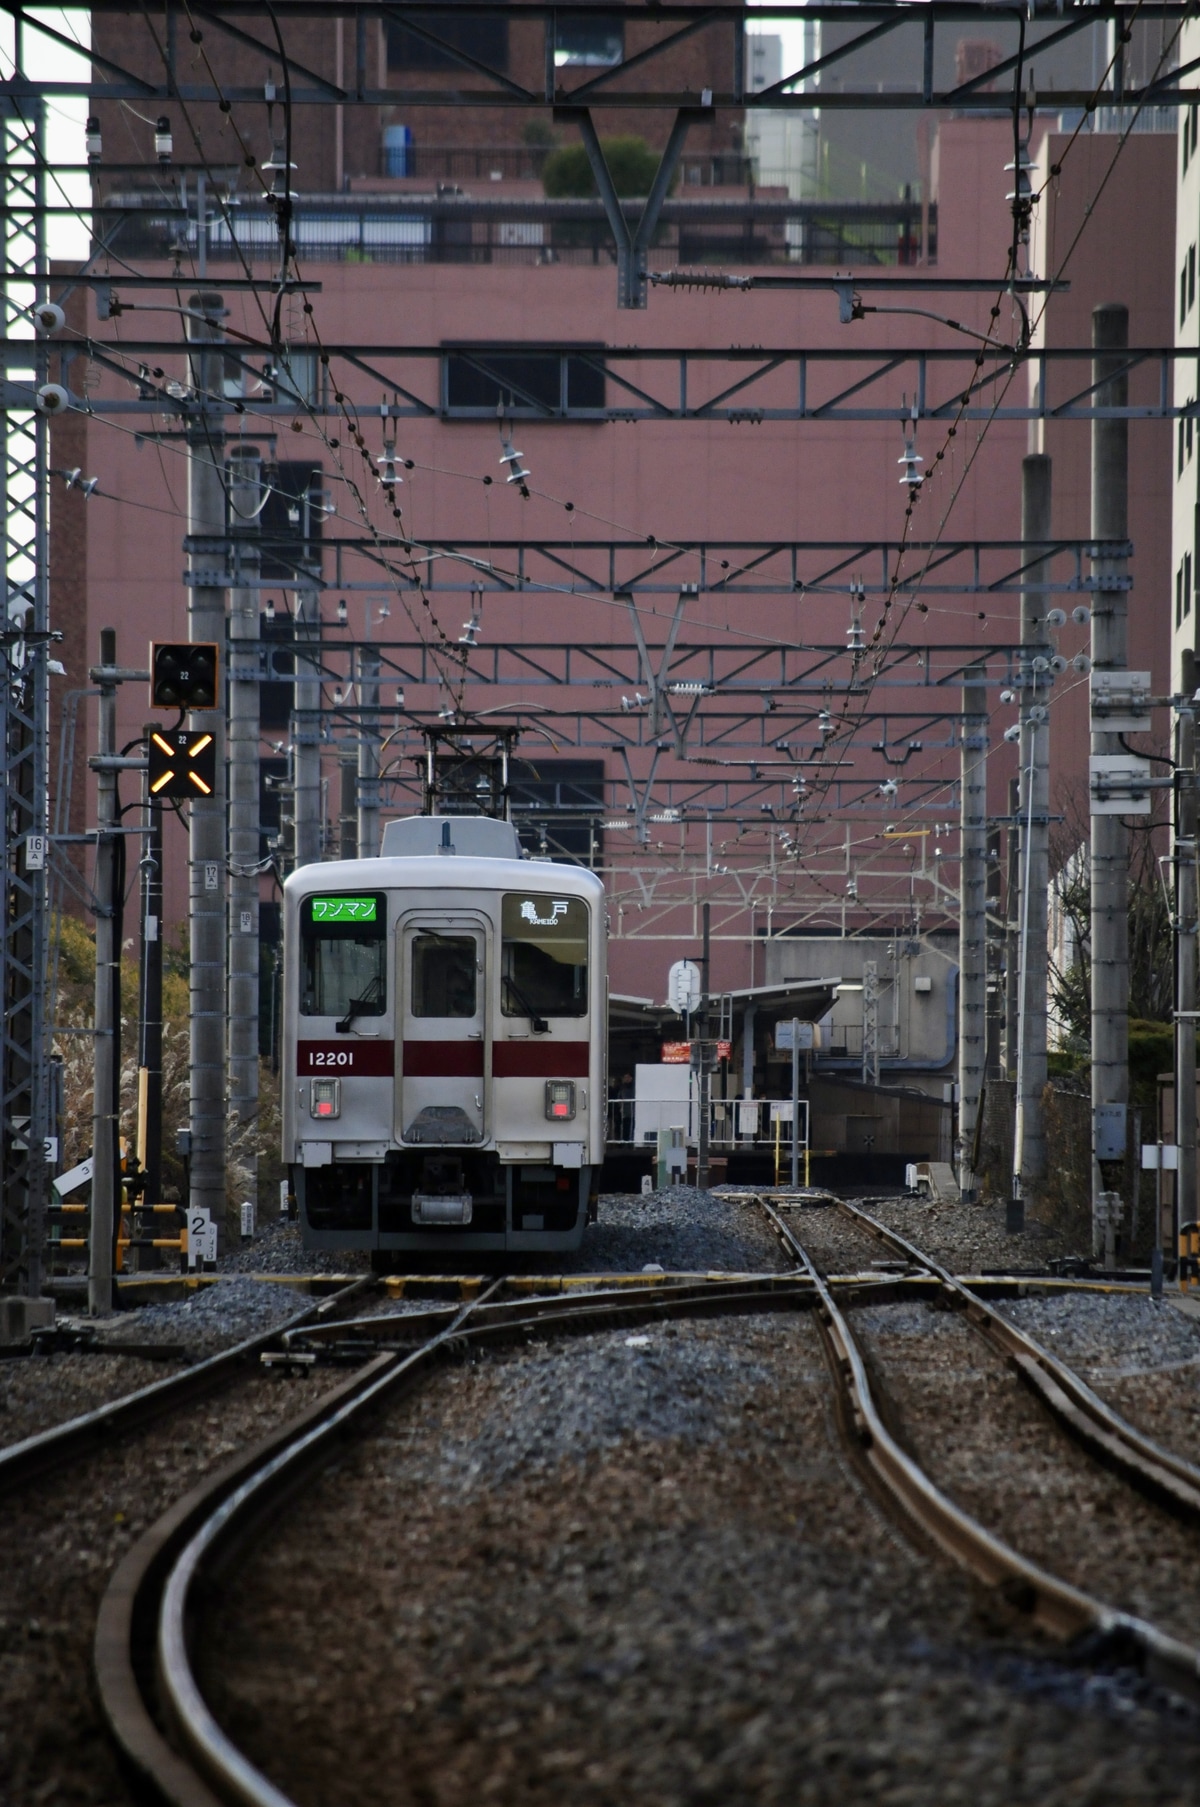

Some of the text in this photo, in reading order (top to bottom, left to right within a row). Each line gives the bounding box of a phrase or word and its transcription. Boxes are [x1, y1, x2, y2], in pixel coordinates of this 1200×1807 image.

[180, 671, 189, 680] 22
[178, 735, 187, 744] 22
[30, 838, 42, 850] 16
[206, 867, 216, 875] 17
[313, 899, 376, 919] ワンマン
[529, 918, 559, 926] KAMEIDO
[309, 1052, 353, 1066] 12201
[191, 1216, 206, 1235] 2
